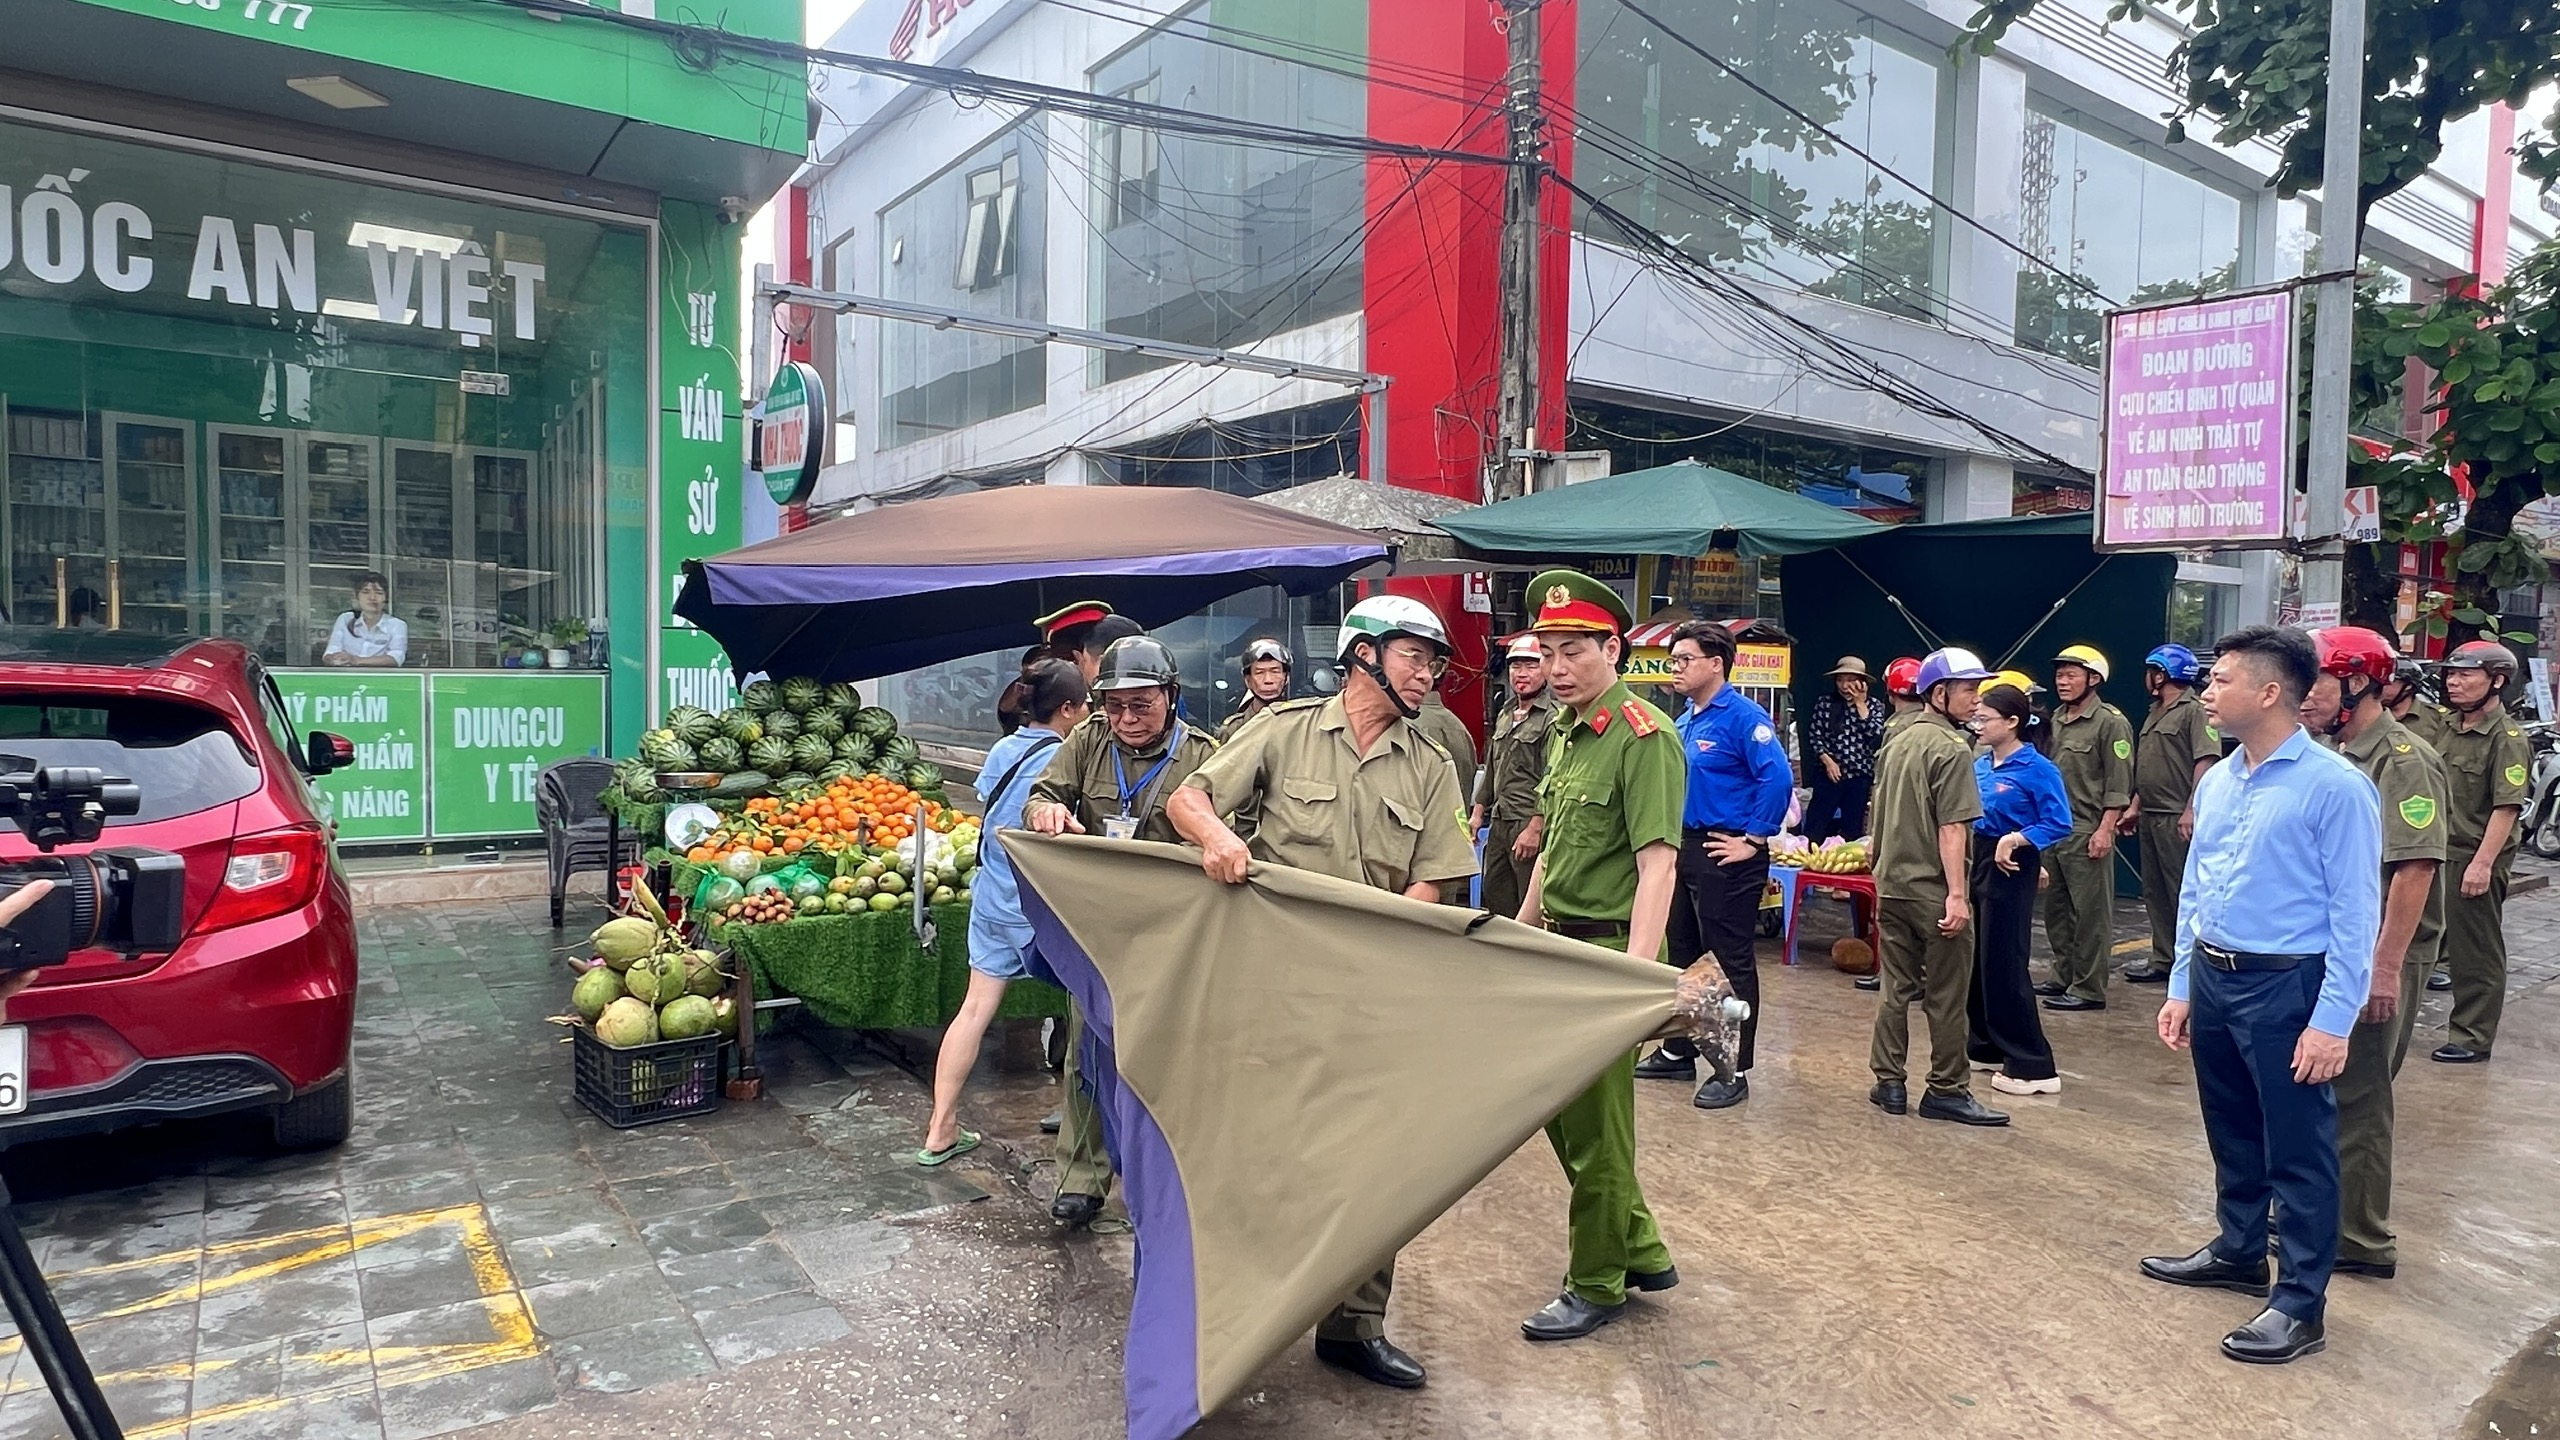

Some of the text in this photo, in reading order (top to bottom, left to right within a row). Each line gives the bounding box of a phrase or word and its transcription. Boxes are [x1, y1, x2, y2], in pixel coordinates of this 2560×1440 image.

[0, 168, 546, 347] ỐC AN VIỆT
[687, 290, 717, 348] TƯ
[2142, 338, 2254, 379] ĐOẠN ĐƯỜNG
[679, 372, 723, 442] VẤN
[2119, 371, 2275, 421] CỰU CHIẾN BINH TỰ QUẢN
[2147, 429, 2166, 453] AN
[2170, 426, 2201, 451] NINH
[2207, 418, 2241, 454] TRẬT
[2244, 418, 2263, 451] TỰ
[2123, 457, 2266, 492] AN TOÀN GIAO THÔNG
[688, 464, 719, 535] SỬ
[2056, 487, 2092, 511] HEAD
[2123, 496, 2264, 534] VỆ SINH MÔI TRƯỜNG
[315, 684, 388, 723] PHẨM
[667, 652, 736, 719] THUỐC
[353, 732, 414, 771] HẨM
[342, 785, 410, 819] NĂNG
[483, 763, 500, 803] Y
